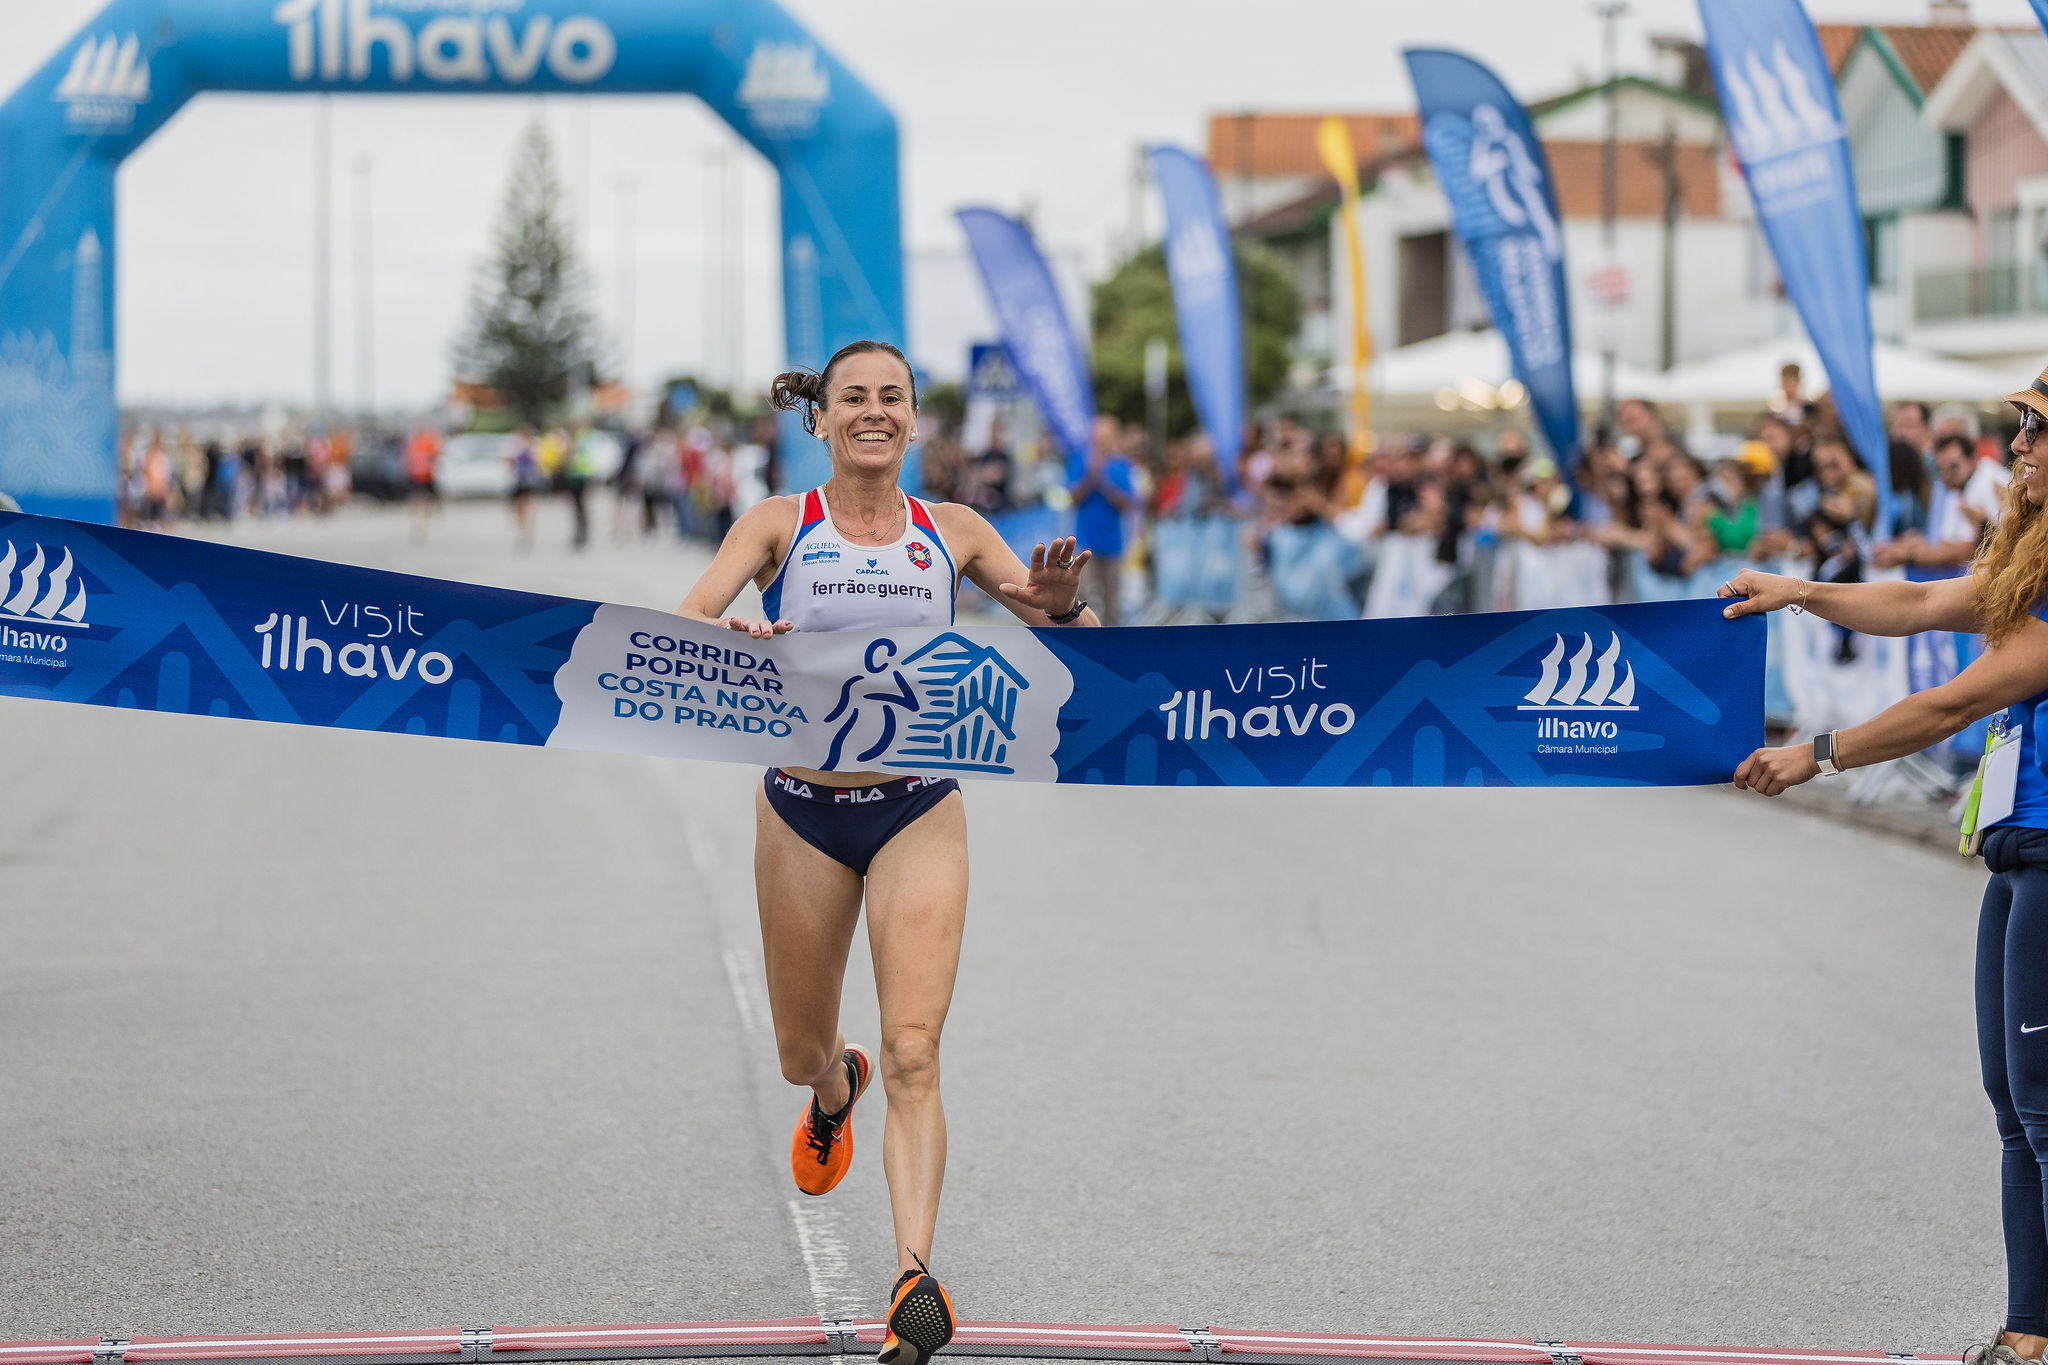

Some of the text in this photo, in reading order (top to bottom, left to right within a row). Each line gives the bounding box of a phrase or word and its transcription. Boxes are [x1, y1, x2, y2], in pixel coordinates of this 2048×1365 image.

[24, 654, 67, 669] Municipal
[630, 631, 781, 677] CORRIDA
[626, 652, 784, 696] POPULAR
[597, 672, 809, 724] COSTA NOVA
[614, 697, 793, 738] DO PRADO
[1537, 744, 1618, 756] Câmara Municipal
[774, 772, 813, 798] FILA
[834, 787, 885, 803] FILA
